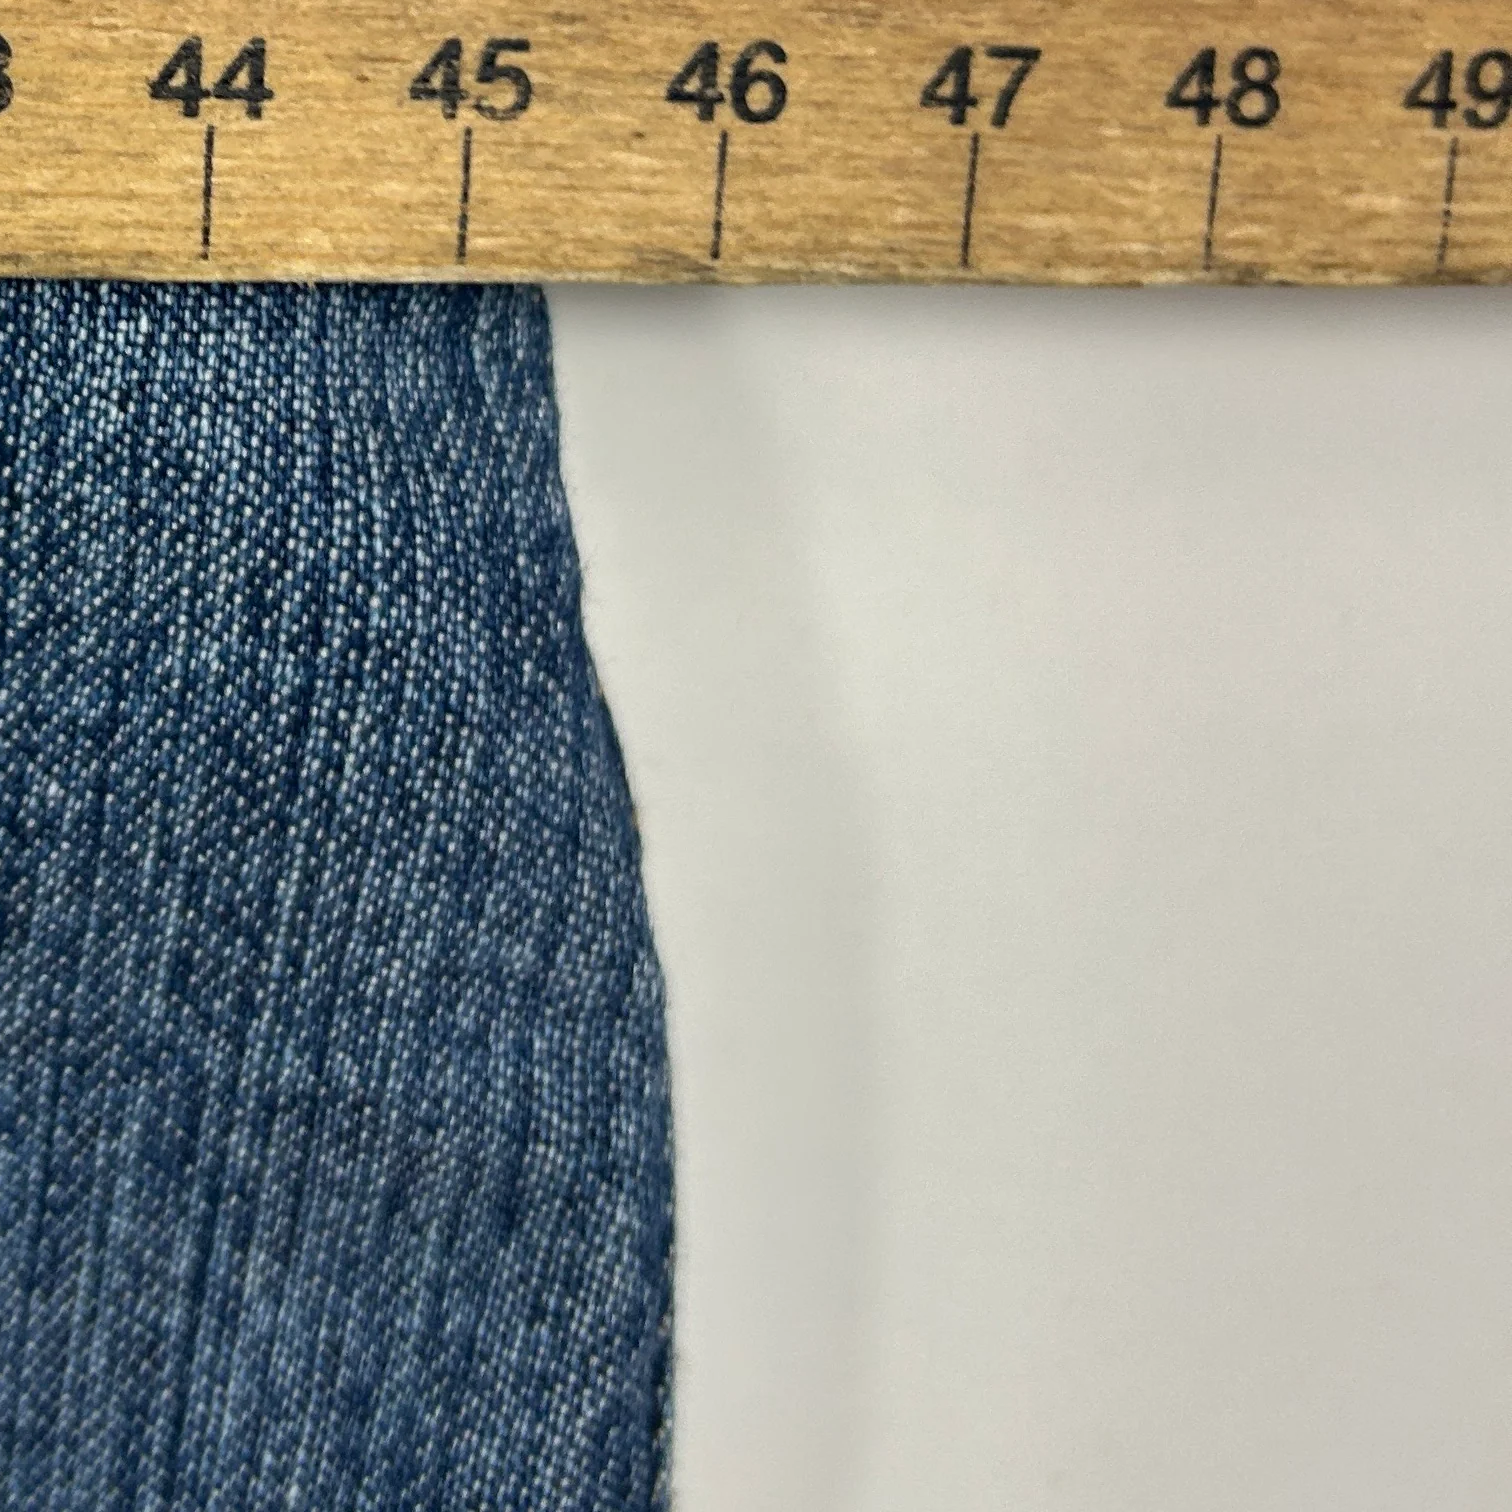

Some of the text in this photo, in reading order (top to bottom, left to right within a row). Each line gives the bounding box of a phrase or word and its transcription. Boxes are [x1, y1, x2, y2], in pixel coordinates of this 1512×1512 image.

[147, 37, 275, 119] 44
[407, 37, 534, 122] 45
[663, 41, 789, 124] 46
[918, 45, 1043, 128] 47
[1164, 46, 1282, 129] 48
[1403, 49, 1512, 129] 49
